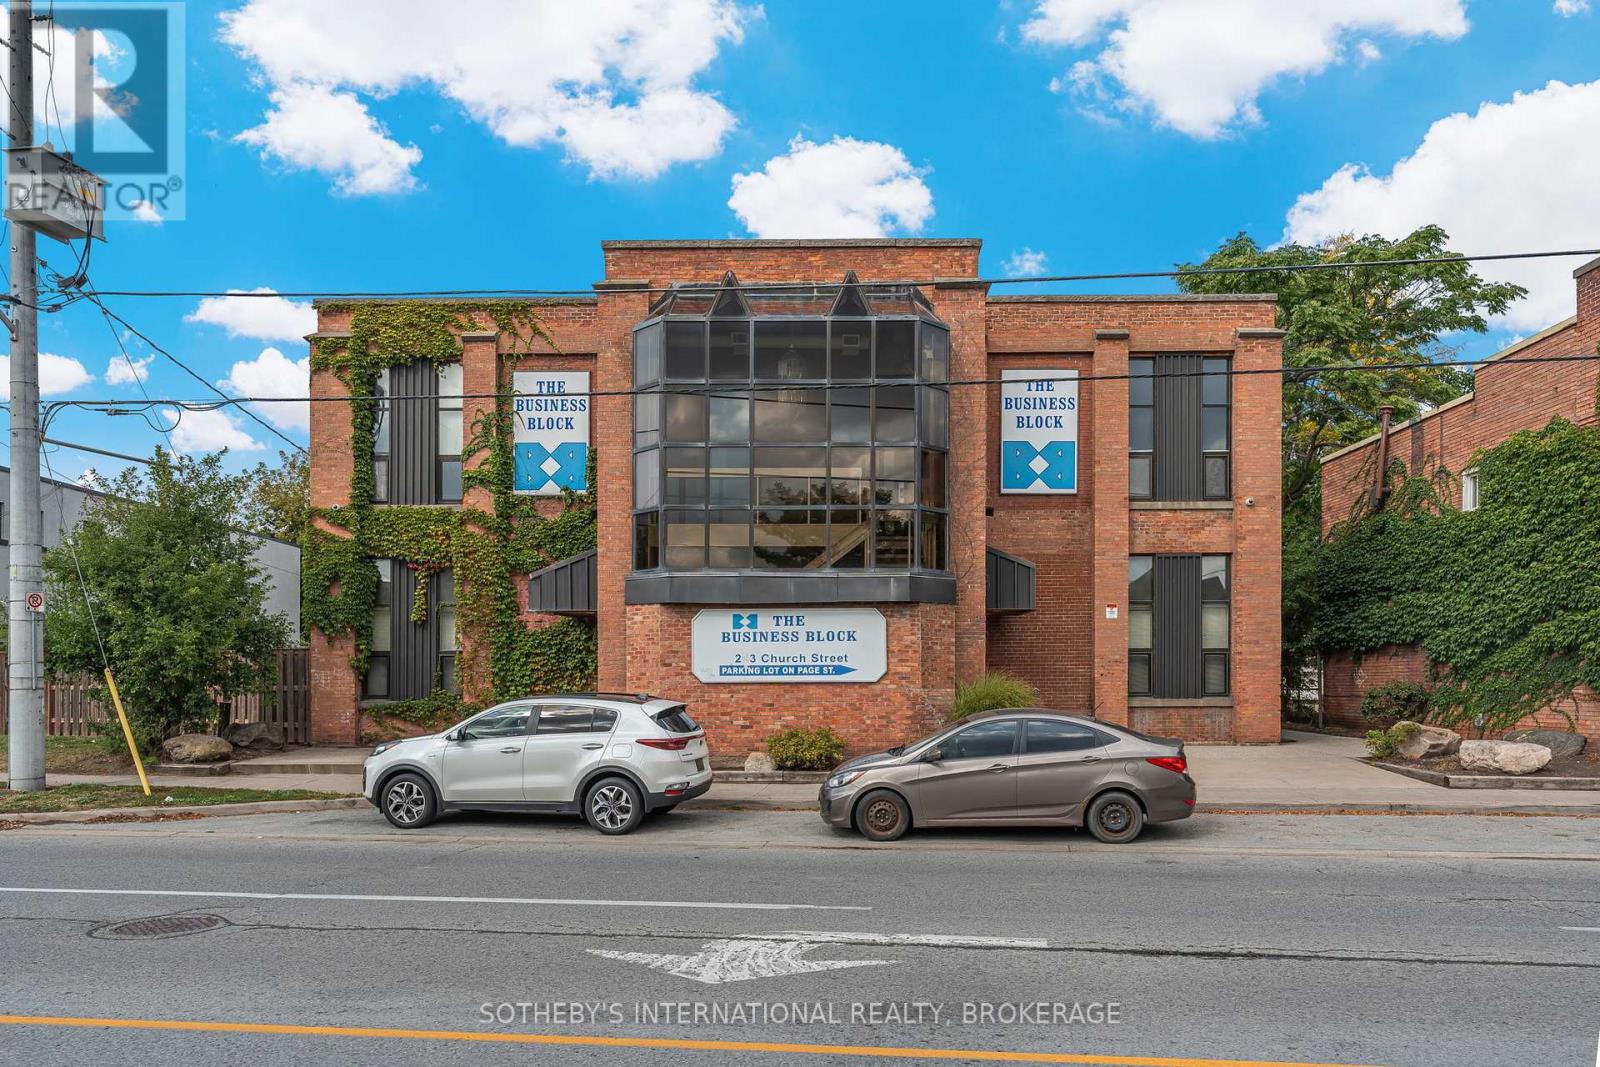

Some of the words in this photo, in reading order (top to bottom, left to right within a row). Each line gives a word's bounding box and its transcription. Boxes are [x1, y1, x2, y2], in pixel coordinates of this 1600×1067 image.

[536, 380, 566, 393] THE
[1026, 380, 1054, 391] THE
[516, 399, 587, 412] BUSINESS
[1004, 398, 1075, 410] BUSINESS
[527, 417, 575, 430] BLOCK
[1016, 416, 1063, 428] BLOCK
[772, 615, 805, 627] THE
[721, 631, 800, 643] BUSINESS
[805, 630, 858, 642] BLOCK
[761, 653, 807, 663] Church
[811, 653, 849, 663] Street
[722, 666, 761, 675] PARKING
[763, 666, 780, 675] LOT
[782, 666, 796, 675] ON
[797, 666, 820, 675] PAGE
[822, 666, 836, 675] ST.
